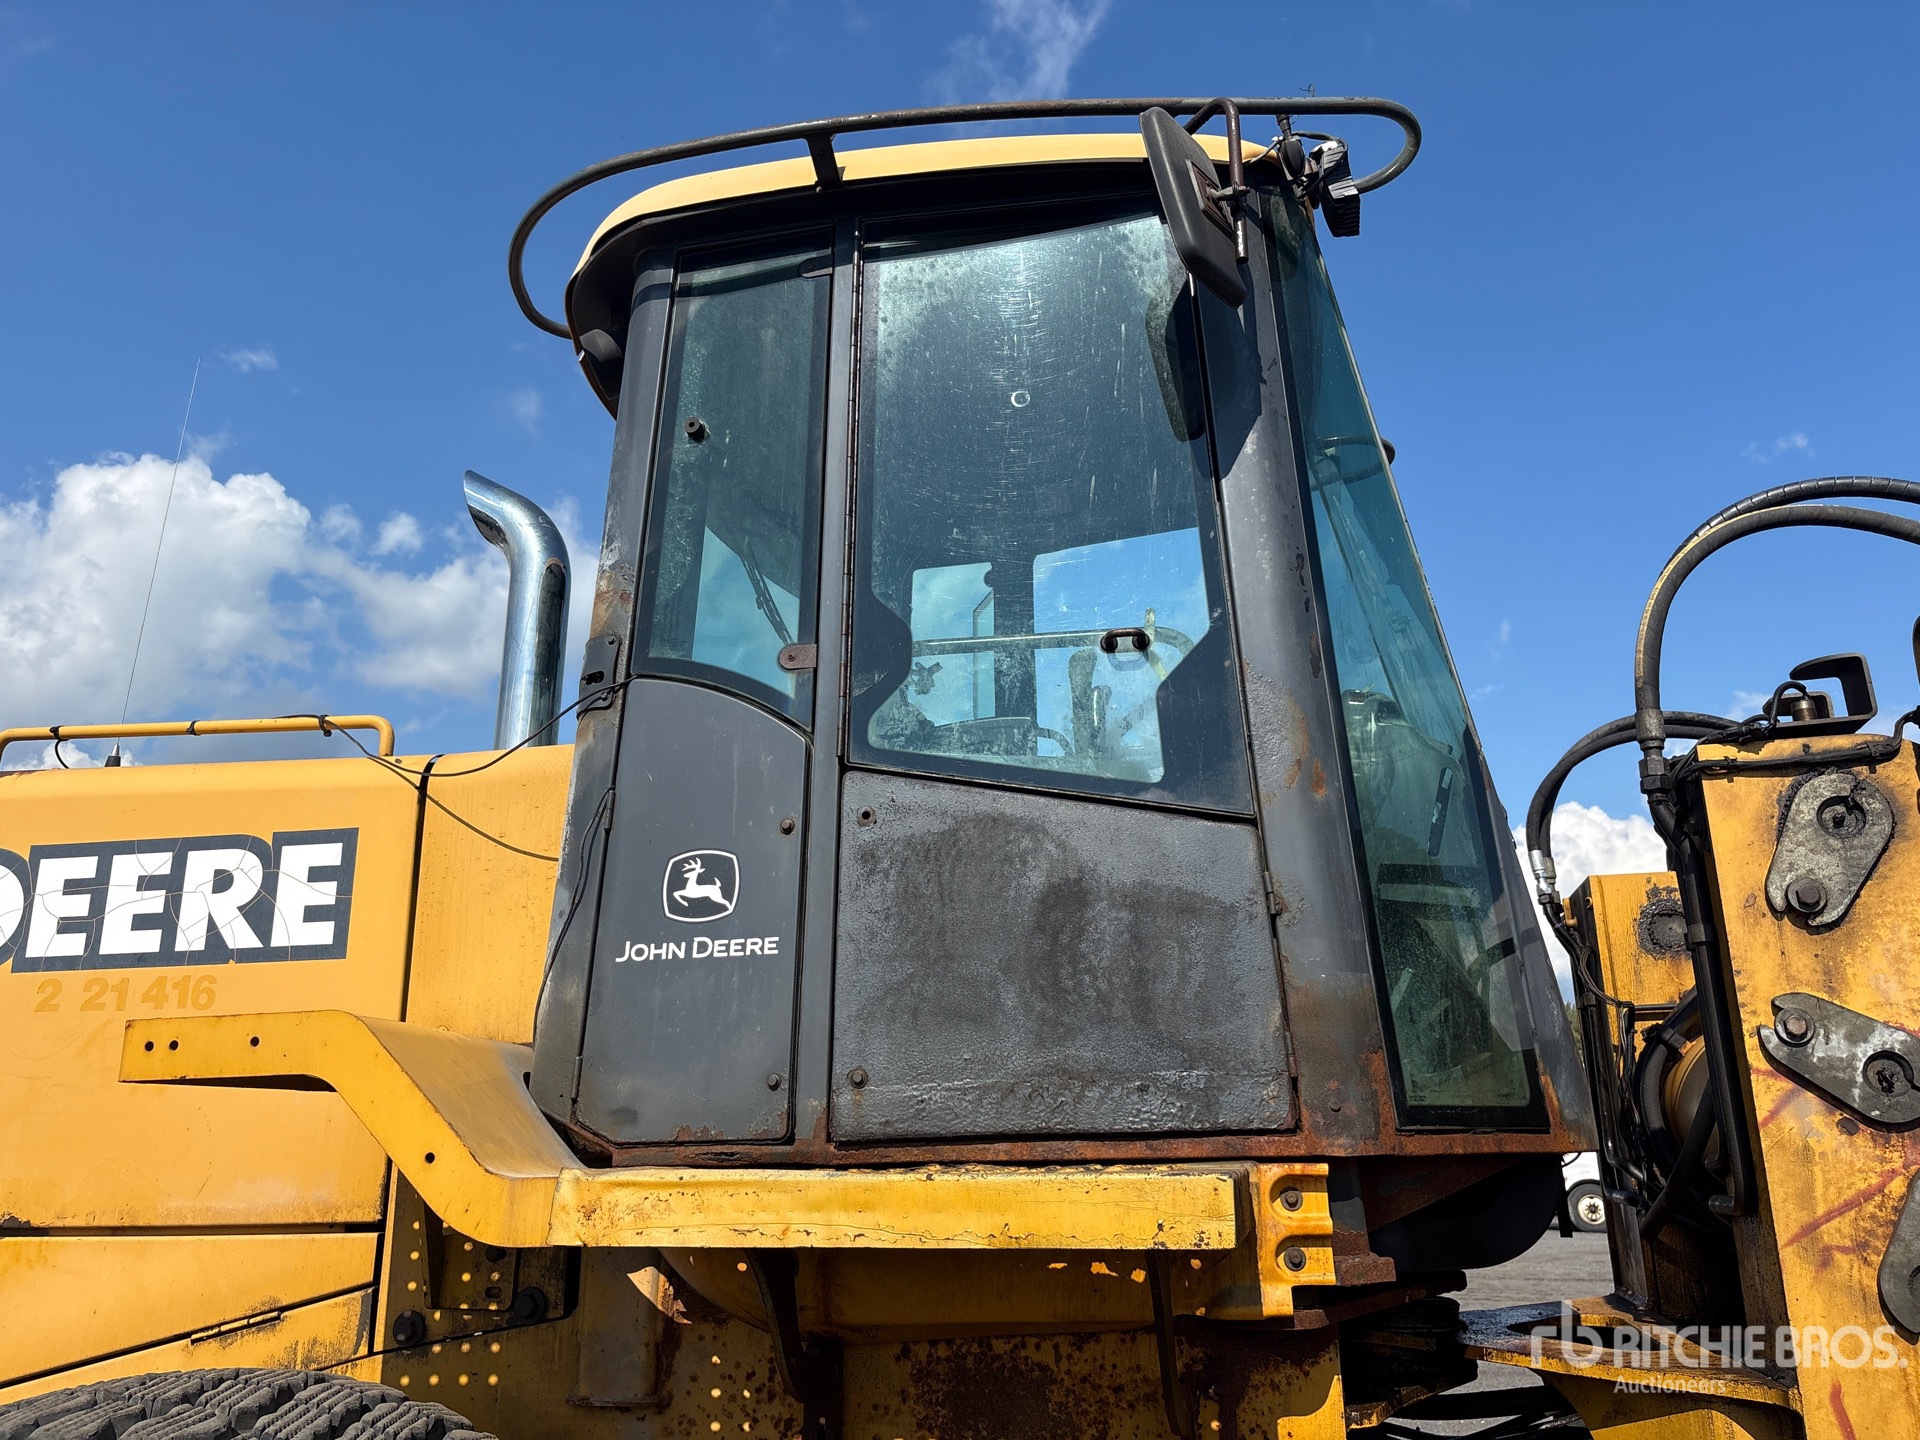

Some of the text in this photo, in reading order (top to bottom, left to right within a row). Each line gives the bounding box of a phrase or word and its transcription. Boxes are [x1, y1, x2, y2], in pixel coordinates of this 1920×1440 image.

[615, 936, 780, 963] JOHN DEERE
[34, 975, 218, 1013] 2 21 416
